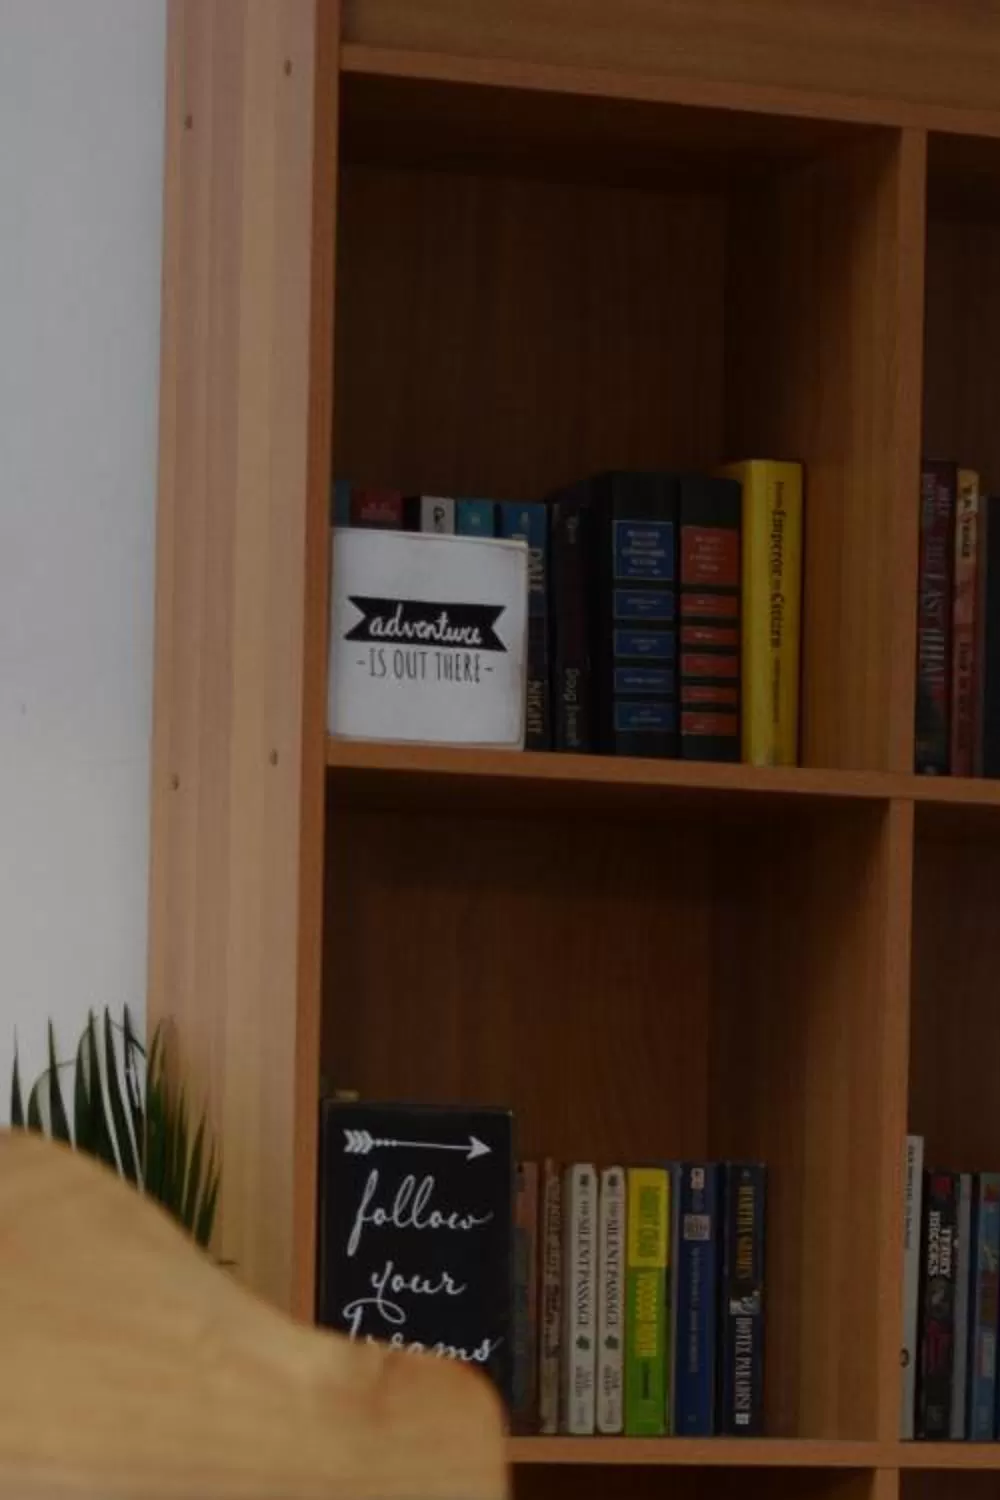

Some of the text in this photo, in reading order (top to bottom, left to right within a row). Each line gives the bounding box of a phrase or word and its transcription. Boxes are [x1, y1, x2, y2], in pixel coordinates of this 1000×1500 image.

[369, 603, 482, 645] adventure
[369, 648, 481, 683] IS OUT THERE
[346, 1168, 494, 1257] follow
[737, 1186, 756, 1233] MARTHA
[577, 1219, 591, 1266] SILENT
[606, 1219, 621, 1266] SILENT
[927, 1210, 941, 1277] BROOKS
[940, 1228, 953, 1278] TERRY
[370, 1260, 468, 1325] your
[576, 1269, 590, 1327] PASSAGE
[606, 1269, 620, 1327] PASSAGE
[735, 1317, 753, 1354] HOTEL
